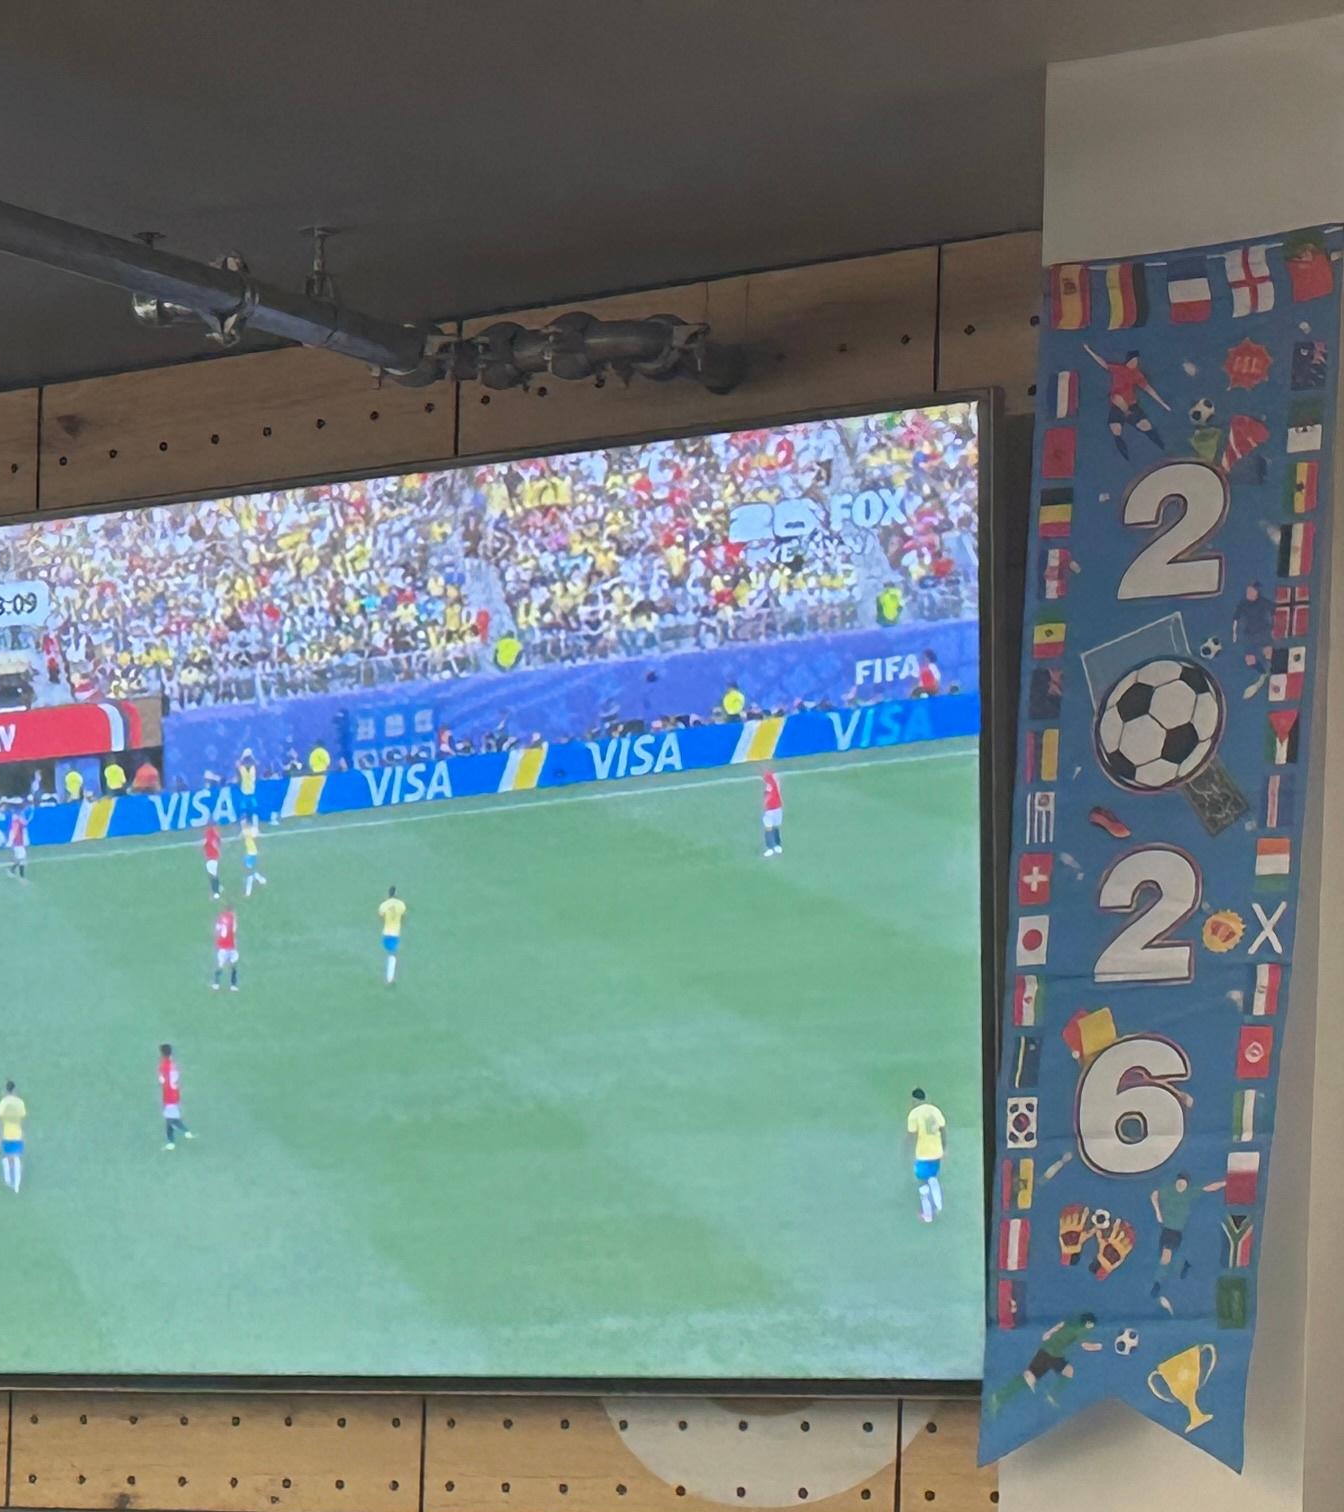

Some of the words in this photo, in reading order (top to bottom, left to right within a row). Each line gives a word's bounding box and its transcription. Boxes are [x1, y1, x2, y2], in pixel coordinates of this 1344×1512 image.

[831, 487, 907, 531] FOX
[856, 654, 919, 686] FIFA
[150, 787, 237, 831] VISA
[364, 762, 452, 806] VISA
[585, 731, 683, 780] VISA
[827, 702, 933, 751] VISA
